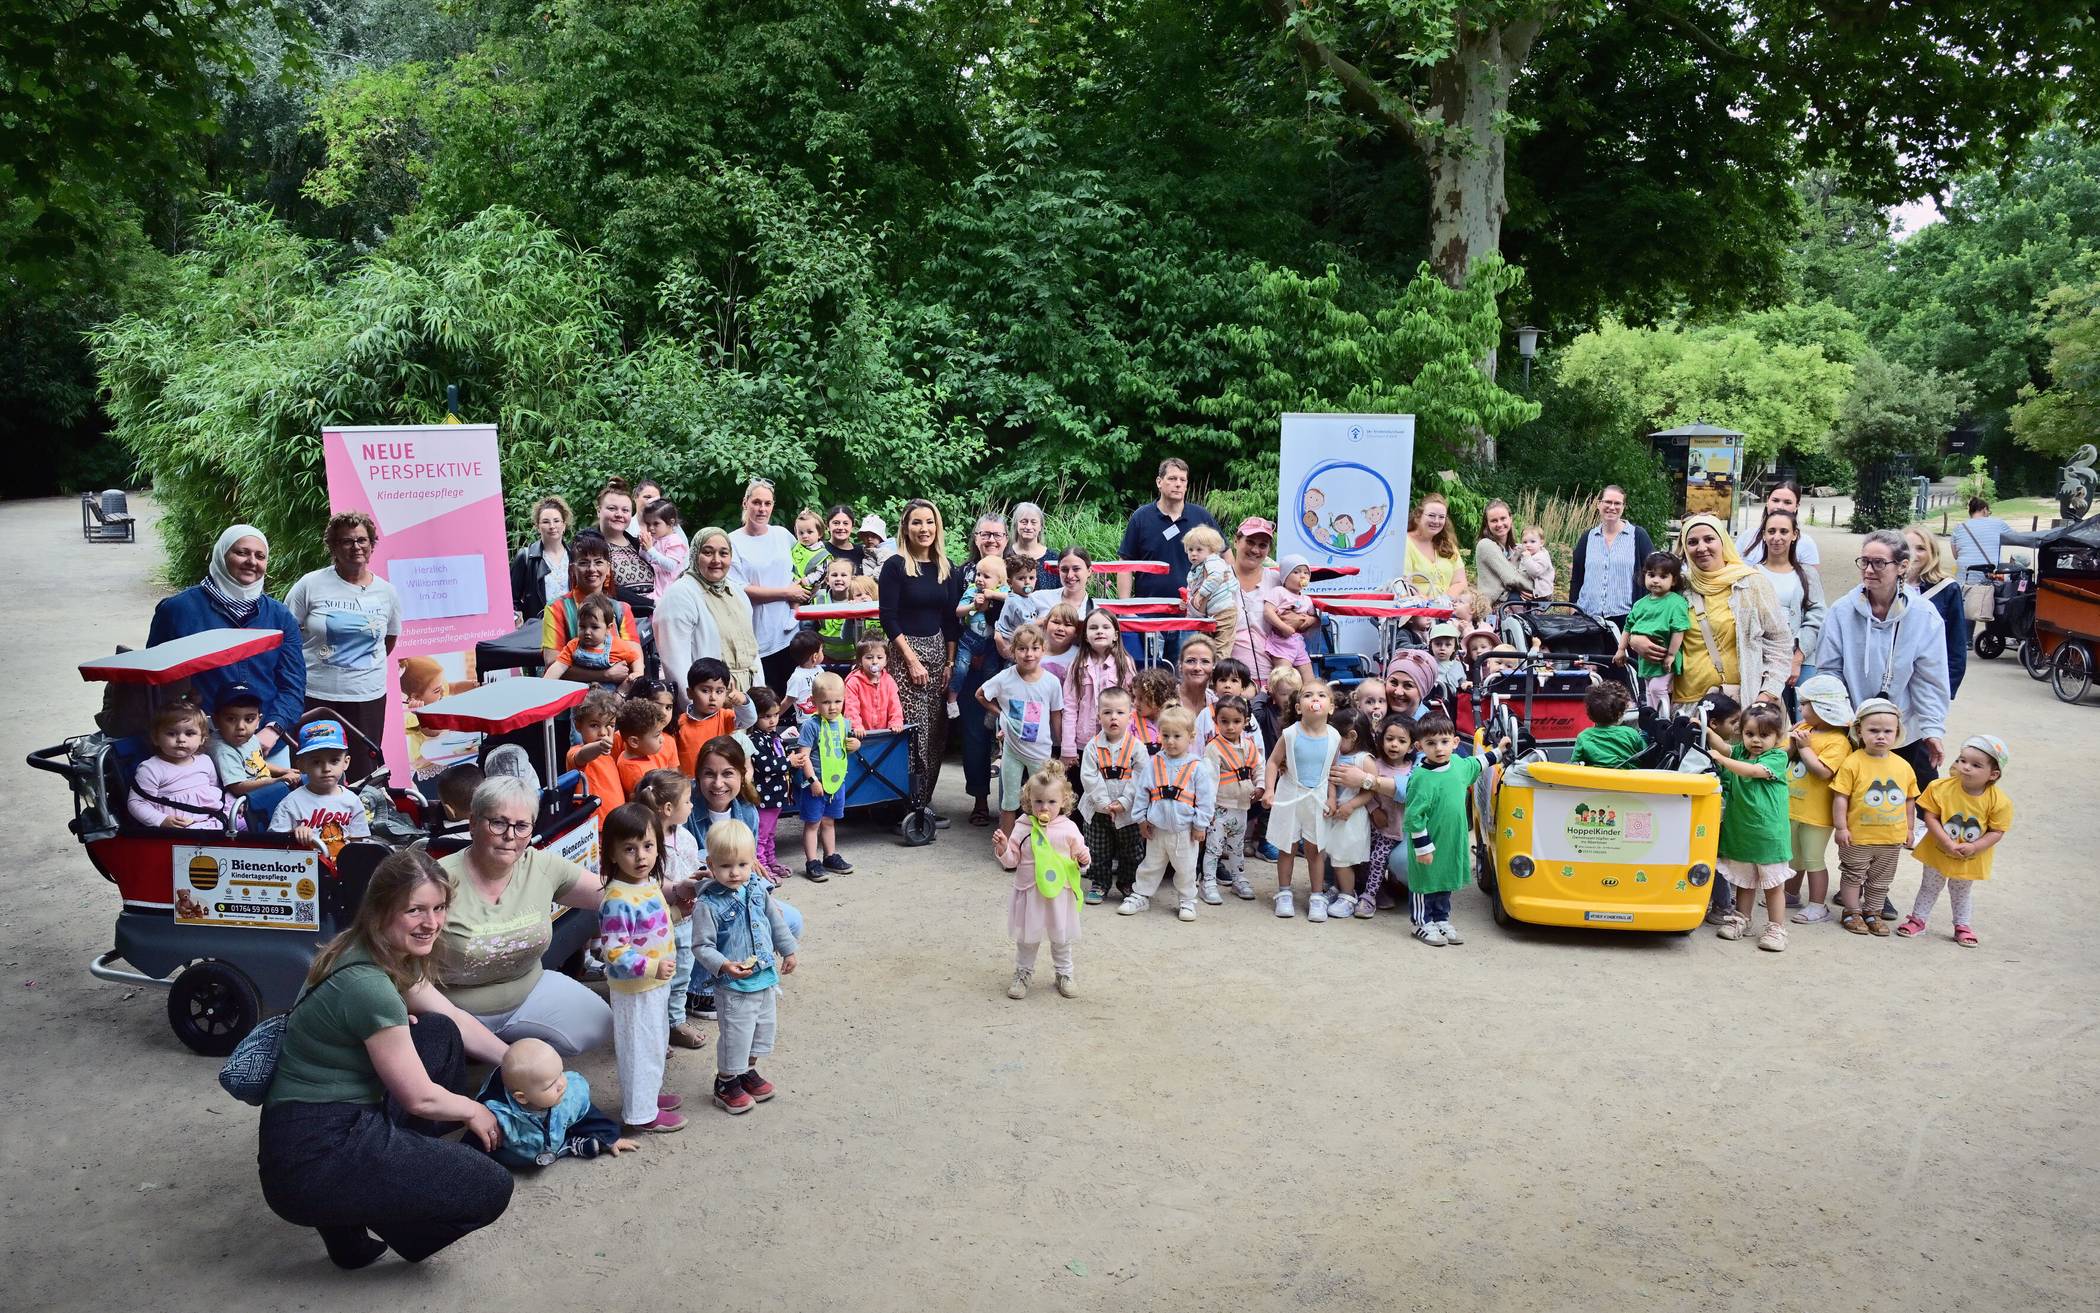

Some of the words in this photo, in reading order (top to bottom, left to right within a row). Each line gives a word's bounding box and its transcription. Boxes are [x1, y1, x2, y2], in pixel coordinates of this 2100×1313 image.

[362, 443, 415, 460] NEUE
[369, 462, 483, 480] PERSPEKTIVE
[377, 487, 464, 500] Kindertagespflege
[414, 564, 448, 574] Herzlich
[406, 577, 458, 588] Willkommen
[432, 591, 448, 600] Zoo
[402, 625, 456, 636] chberatungen.
[301, 808, 352, 829] Meow
[1567, 826, 1621, 837] HoppelKinder
[562, 830, 594, 857] Bienenkorb
[231, 859, 306, 873] Bienenkorb
[231, 872, 288, 881] Kindertagespflege
[230, 904, 251, 913] 01764
[251, 905, 260, 913] 59
[261, 906, 270, 914] 20
[270, 906, 279, 914] 69
[280, 906, 285, 914] 3
